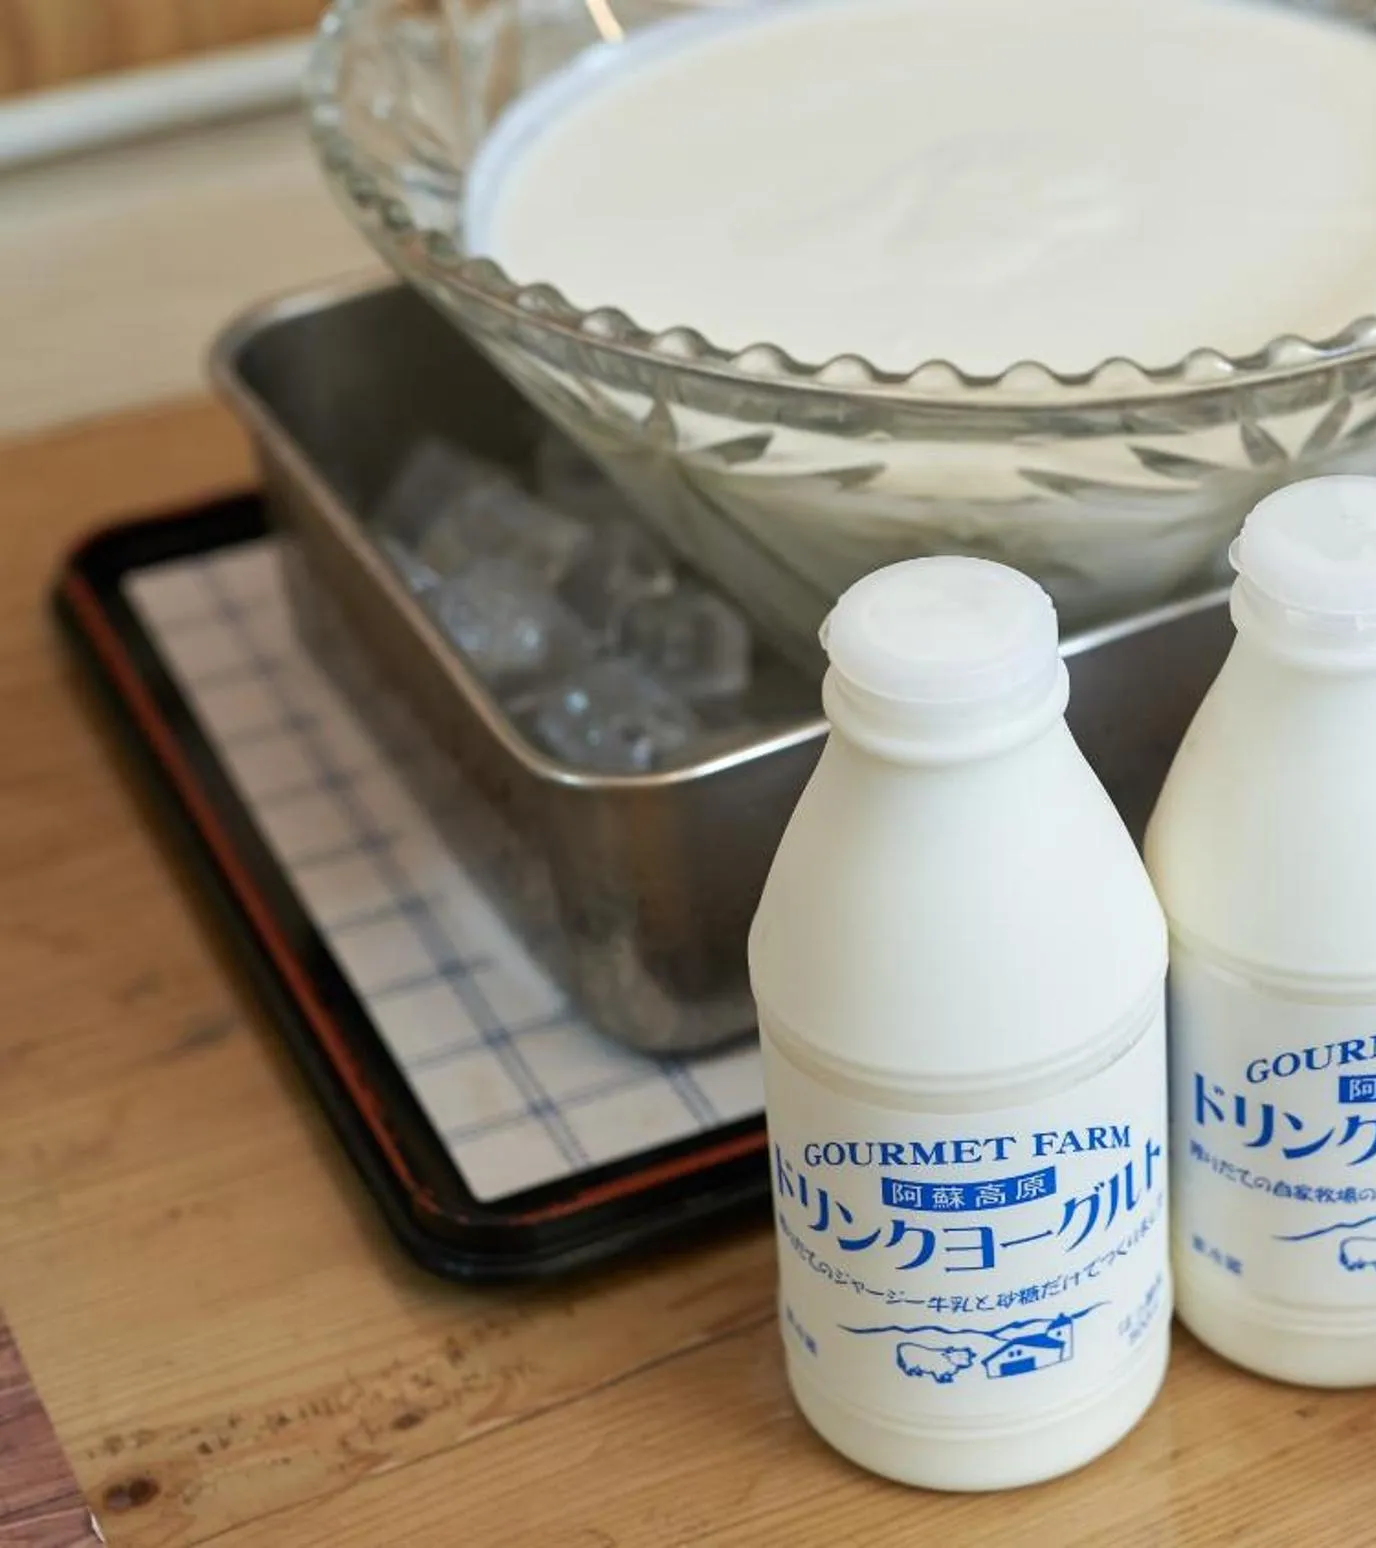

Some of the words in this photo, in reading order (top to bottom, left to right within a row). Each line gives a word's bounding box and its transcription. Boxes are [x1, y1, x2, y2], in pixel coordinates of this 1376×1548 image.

[804, 1136, 1017, 1167] GOURMET
[1031, 1125, 1131, 1157] FARM
[774, 1138, 1161, 1273] ドリンクヨーグルト
[892, 1174, 1047, 1210] 阿蘇高原
